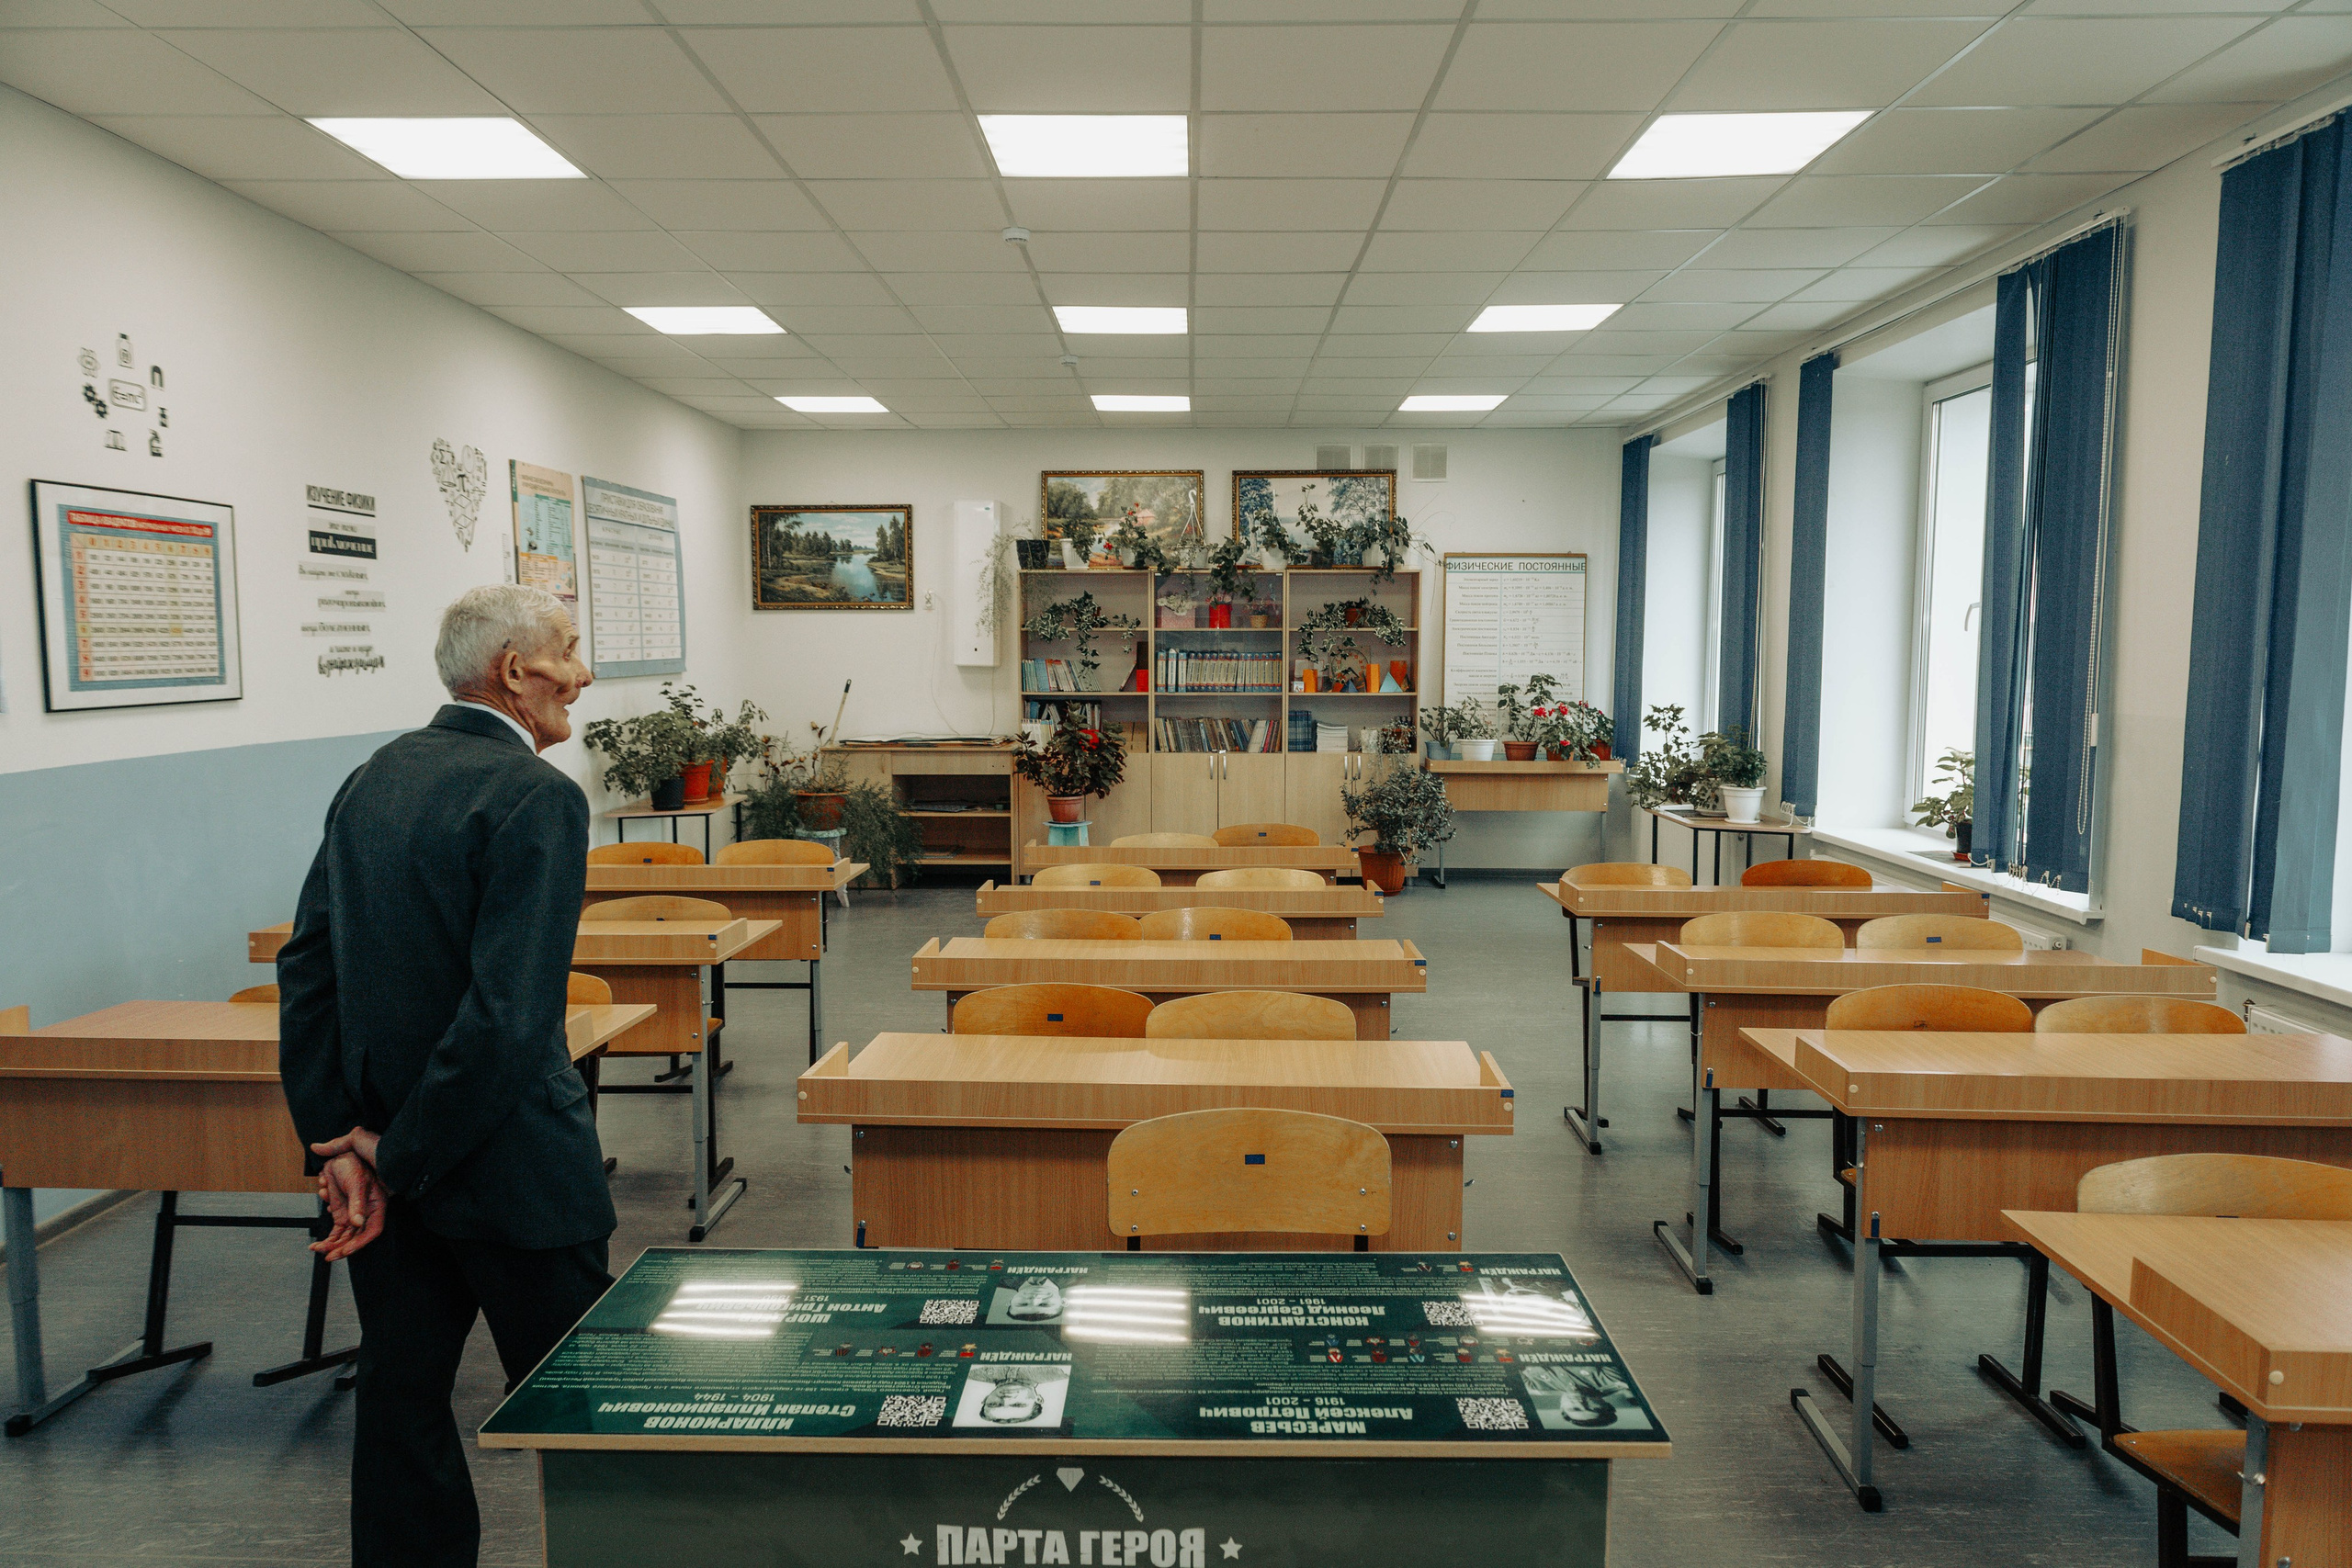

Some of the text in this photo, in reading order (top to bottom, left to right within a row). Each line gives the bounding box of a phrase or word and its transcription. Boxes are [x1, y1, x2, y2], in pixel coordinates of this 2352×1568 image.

[306, 484, 375, 511] ИЗУЧЕНИЕ ФИЗИКИ
[1446, 561, 1586, 571] ФИЗИЧЕСКИЕ ПОСТОЯННЫЕ
[1007, 1266, 1089, 1274] НАГРАЖДЁН
[1479, 1267, 1562, 1276] НАГРАЖДЁН
[826, 1303, 887, 1314] Антон
[1198, 1304, 1385, 1315] Леонид Сергеевич
[1217, 1315, 1369, 1326] КОНСТАНТИНОВ
[979, 1350, 1072, 1362] НАГРАЖДЁН
[1518, 1352, 1612, 1364] НАГРАЖДЁН
[694, 1393, 727, 1402] 1944
[741, 1393, 775, 1402] 1904
[1265, 1396, 1299, 1405] 2001
[1315, 1396, 1346, 1405] 1916
[597, 1402, 856, 1417] Степан Илларионович
[1199, 1405, 1413, 1420] Алексей Петрович
[643, 1416, 795, 1430] ИЛЛАРИОНОВ
[1250, 1420, 1367, 1434] МАРЕСЬЕВ
[936, 1524, 1205, 1568] ПАРТА ГЕРОЯ
